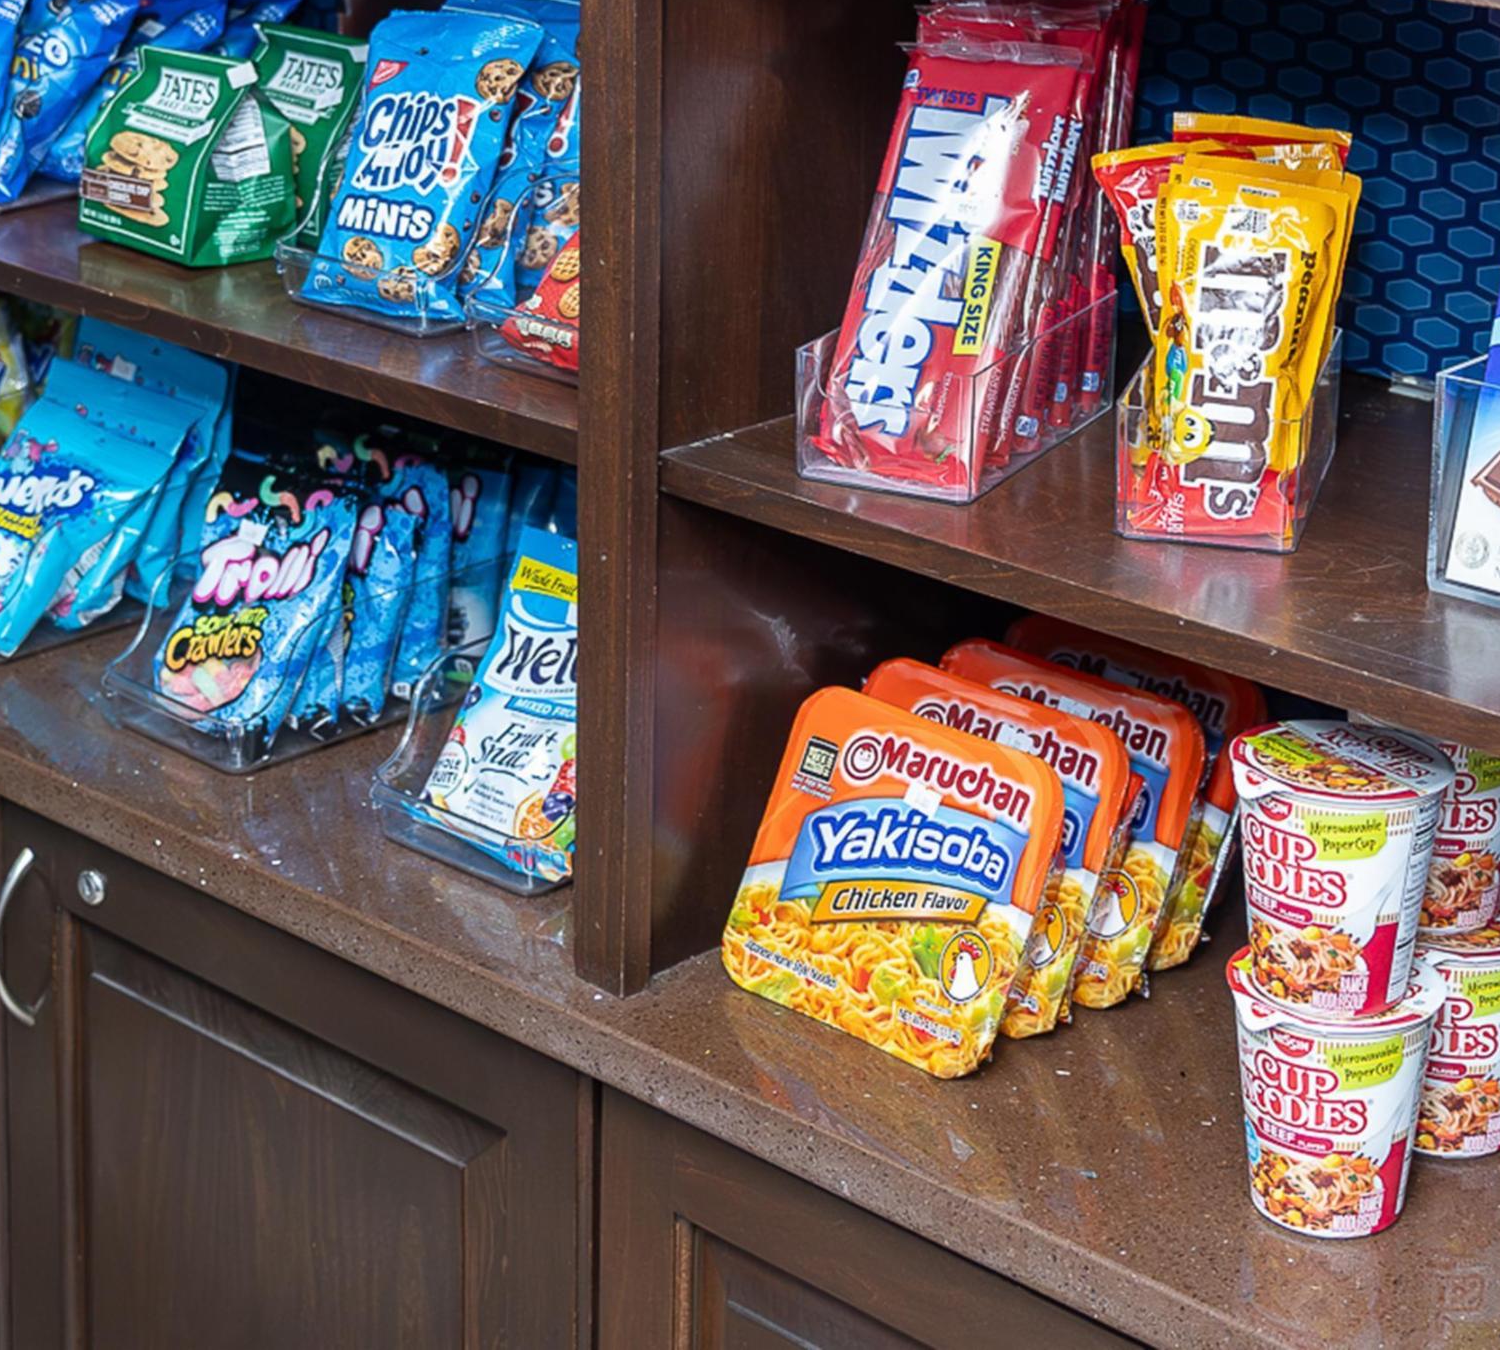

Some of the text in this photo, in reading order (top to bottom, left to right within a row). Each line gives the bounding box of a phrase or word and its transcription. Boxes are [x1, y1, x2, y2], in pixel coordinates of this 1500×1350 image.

[164, 73, 217, 107] TATE'S
[287, 56, 341, 89] TATE'S
[916, 86, 978, 106] TWISTS
[363, 91, 451, 150] Chips
[960, 246, 995, 346] KING SIZE
[193, 529, 330, 603] Trolli
[166, 624, 262, 670] Crawlers
[515, 699, 548, 713] MIXED
[880, 736, 1031, 823] Maruchan
[1246, 817, 1317, 863] CUP
[1310, 817, 1382, 836] Microwavable
[815, 814, 1004, 883] Yakisoba
[832, 889, 970, 912] Chicken Flavor
[1255, 1051, 1338, 1097] CUP
[1331, 1043, 1400, 1067] Microwavable
[1262, 1118, 1296, 1141] BEEF
